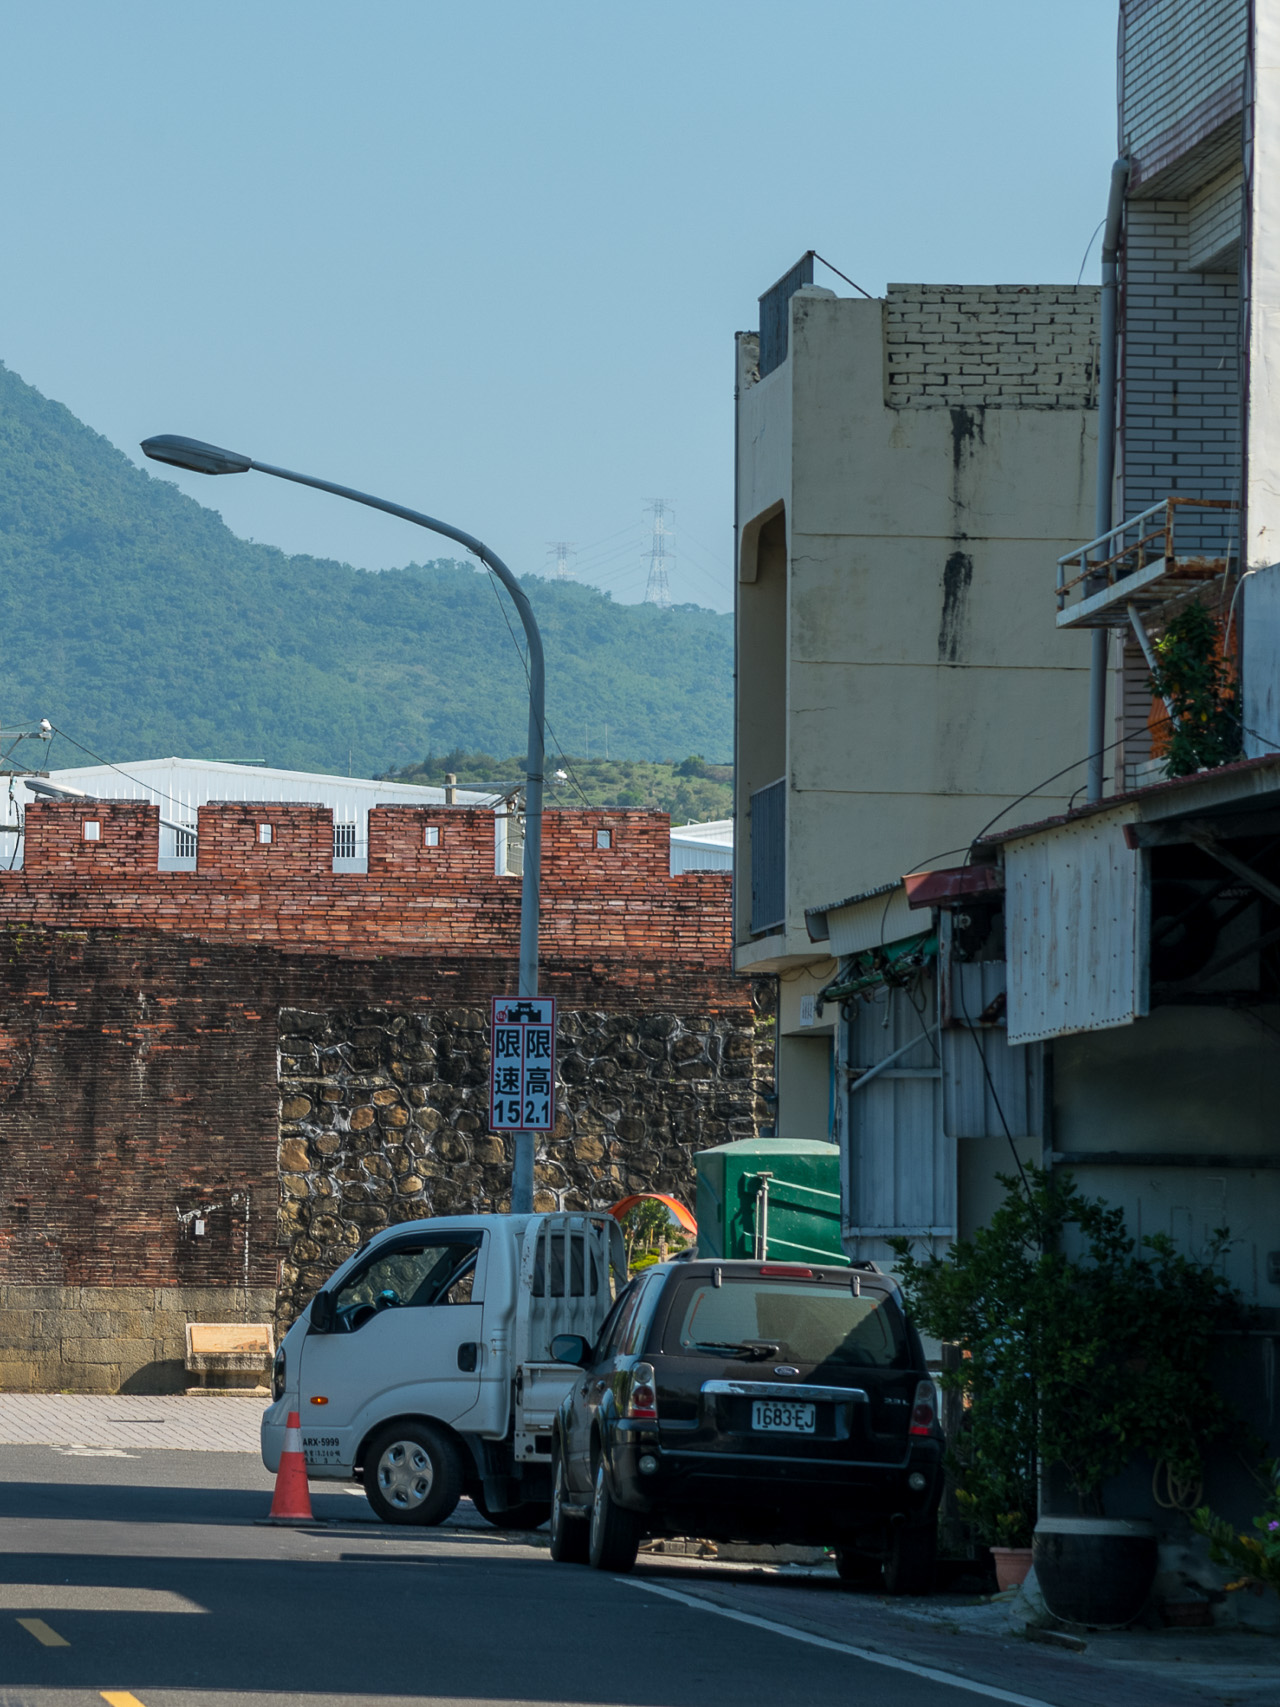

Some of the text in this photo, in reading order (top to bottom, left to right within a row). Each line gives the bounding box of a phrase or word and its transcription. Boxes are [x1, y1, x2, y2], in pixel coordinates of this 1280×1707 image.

[494, 1029, 520, 1124] 限速 15
[525, 1029, 551, 1124] 限高 2.1
